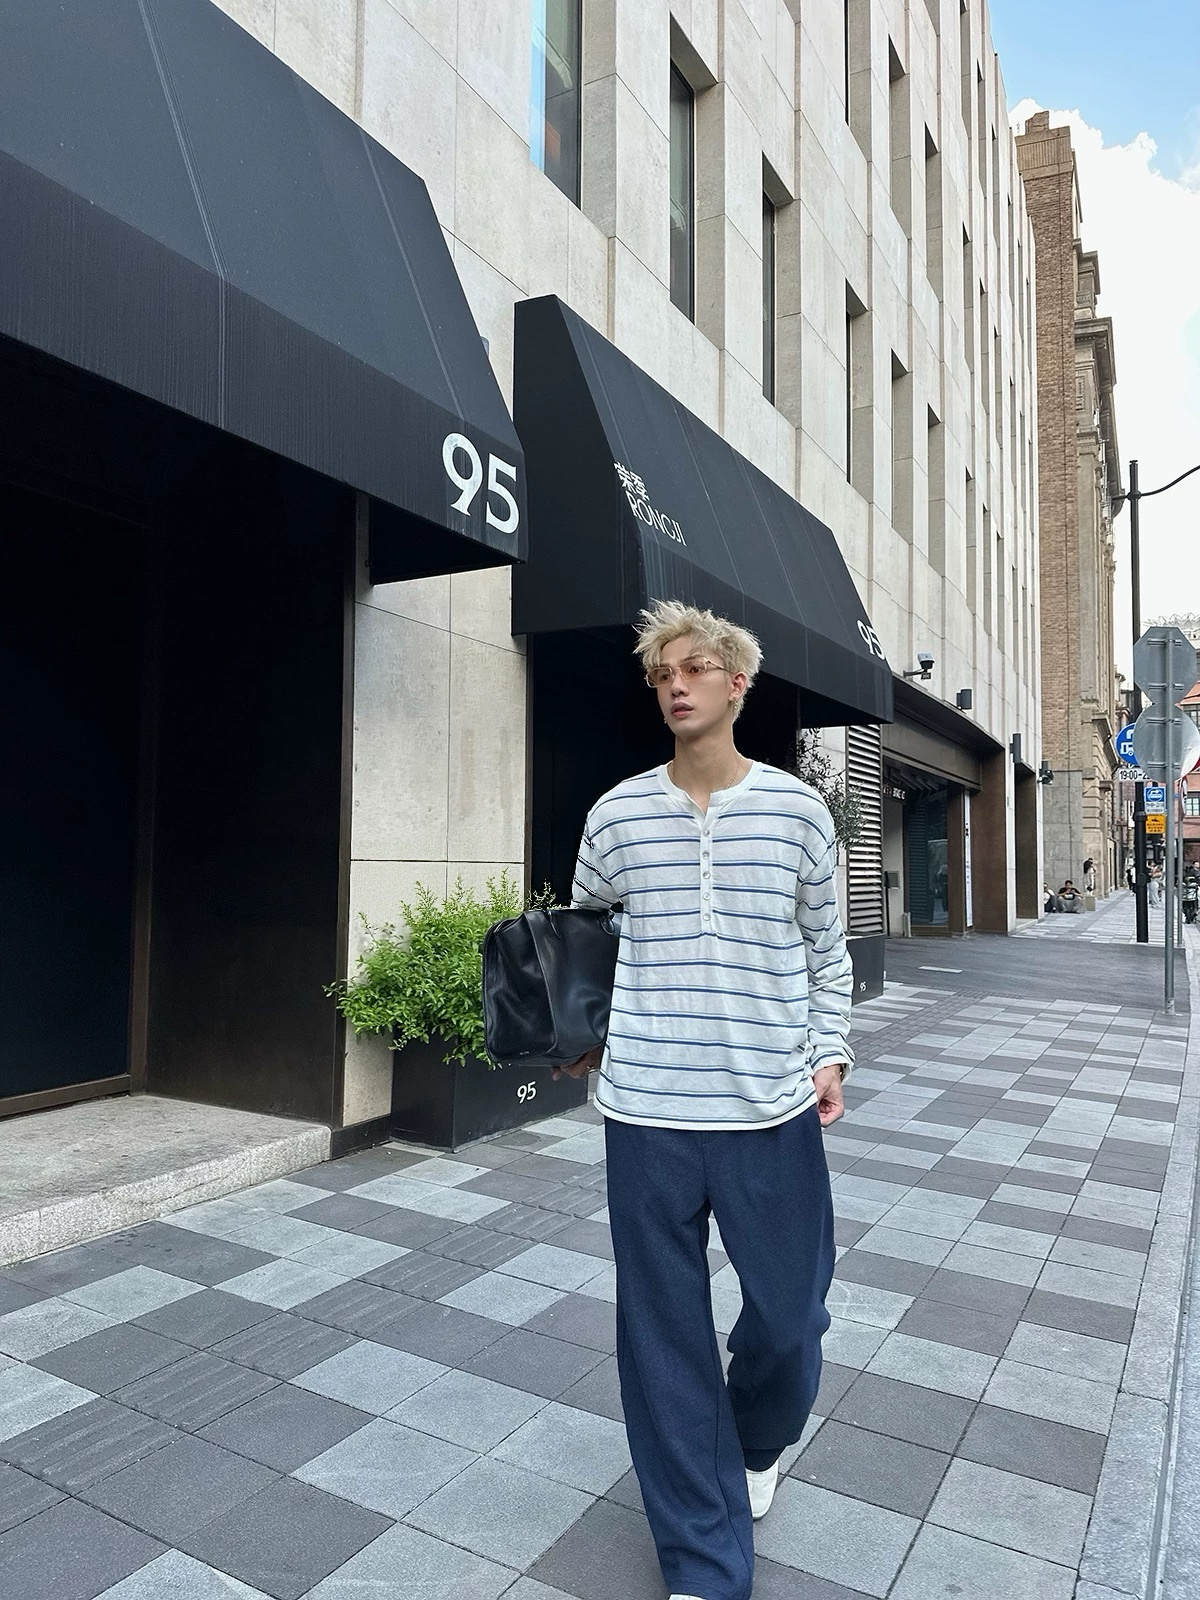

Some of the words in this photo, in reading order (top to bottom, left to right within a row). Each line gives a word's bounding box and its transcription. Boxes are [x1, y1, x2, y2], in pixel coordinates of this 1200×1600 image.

[442, 432, 519, 534] 95
[626, 490, 687, 547] RONGJI
[857, 620, 885, 660] 95
[517, 1081, 537, 1104] 95
